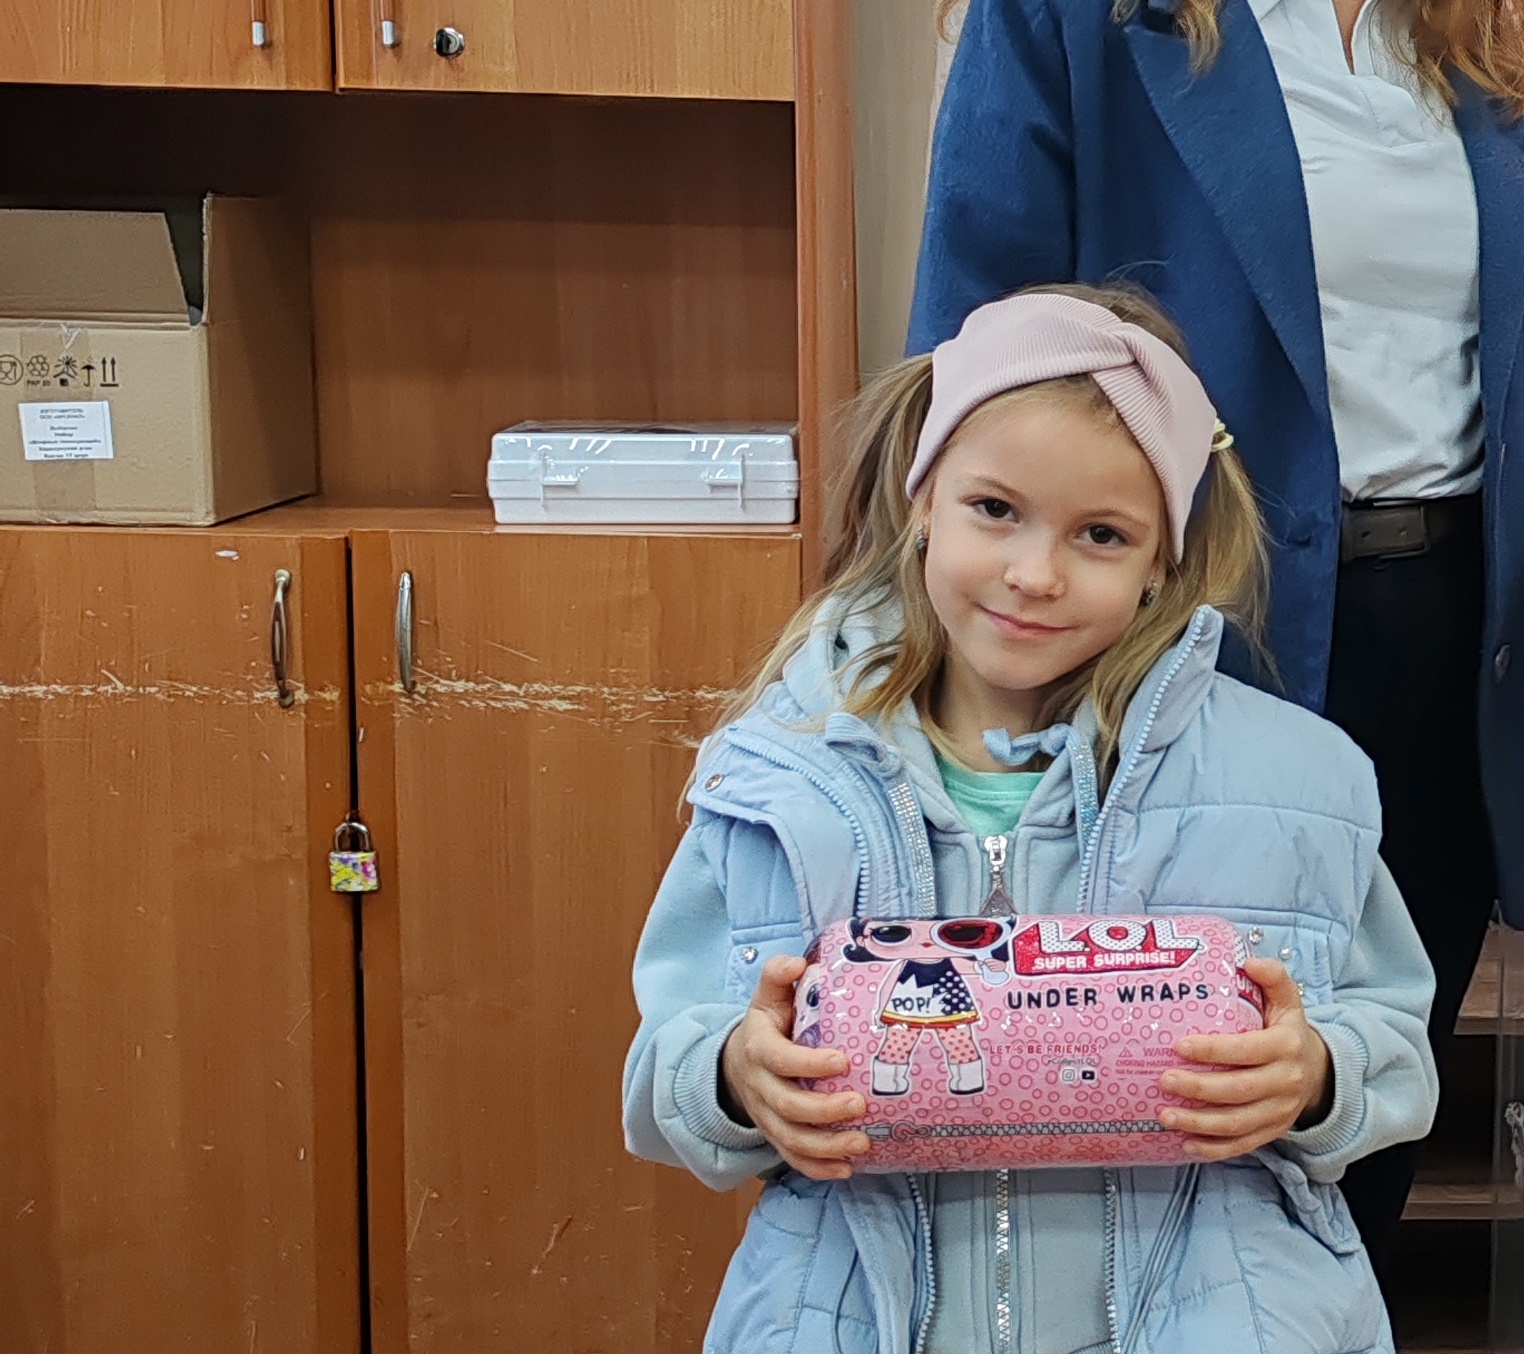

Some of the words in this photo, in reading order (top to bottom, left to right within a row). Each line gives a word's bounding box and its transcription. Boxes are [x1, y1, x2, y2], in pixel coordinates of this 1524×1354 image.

[1034, 954, 1087, 970] SUPER
[1094, 951, 1176, 968] SURPRISE!
[891, 996, 931, 1014] POP!
[1008, 987, 1098, 1010] UNDER
[1117, 983, 1209, 1003] WRAPS
[1027, 1045, 1042, 1054] BE
[1143, 1047, 1176, 1057] WARN
